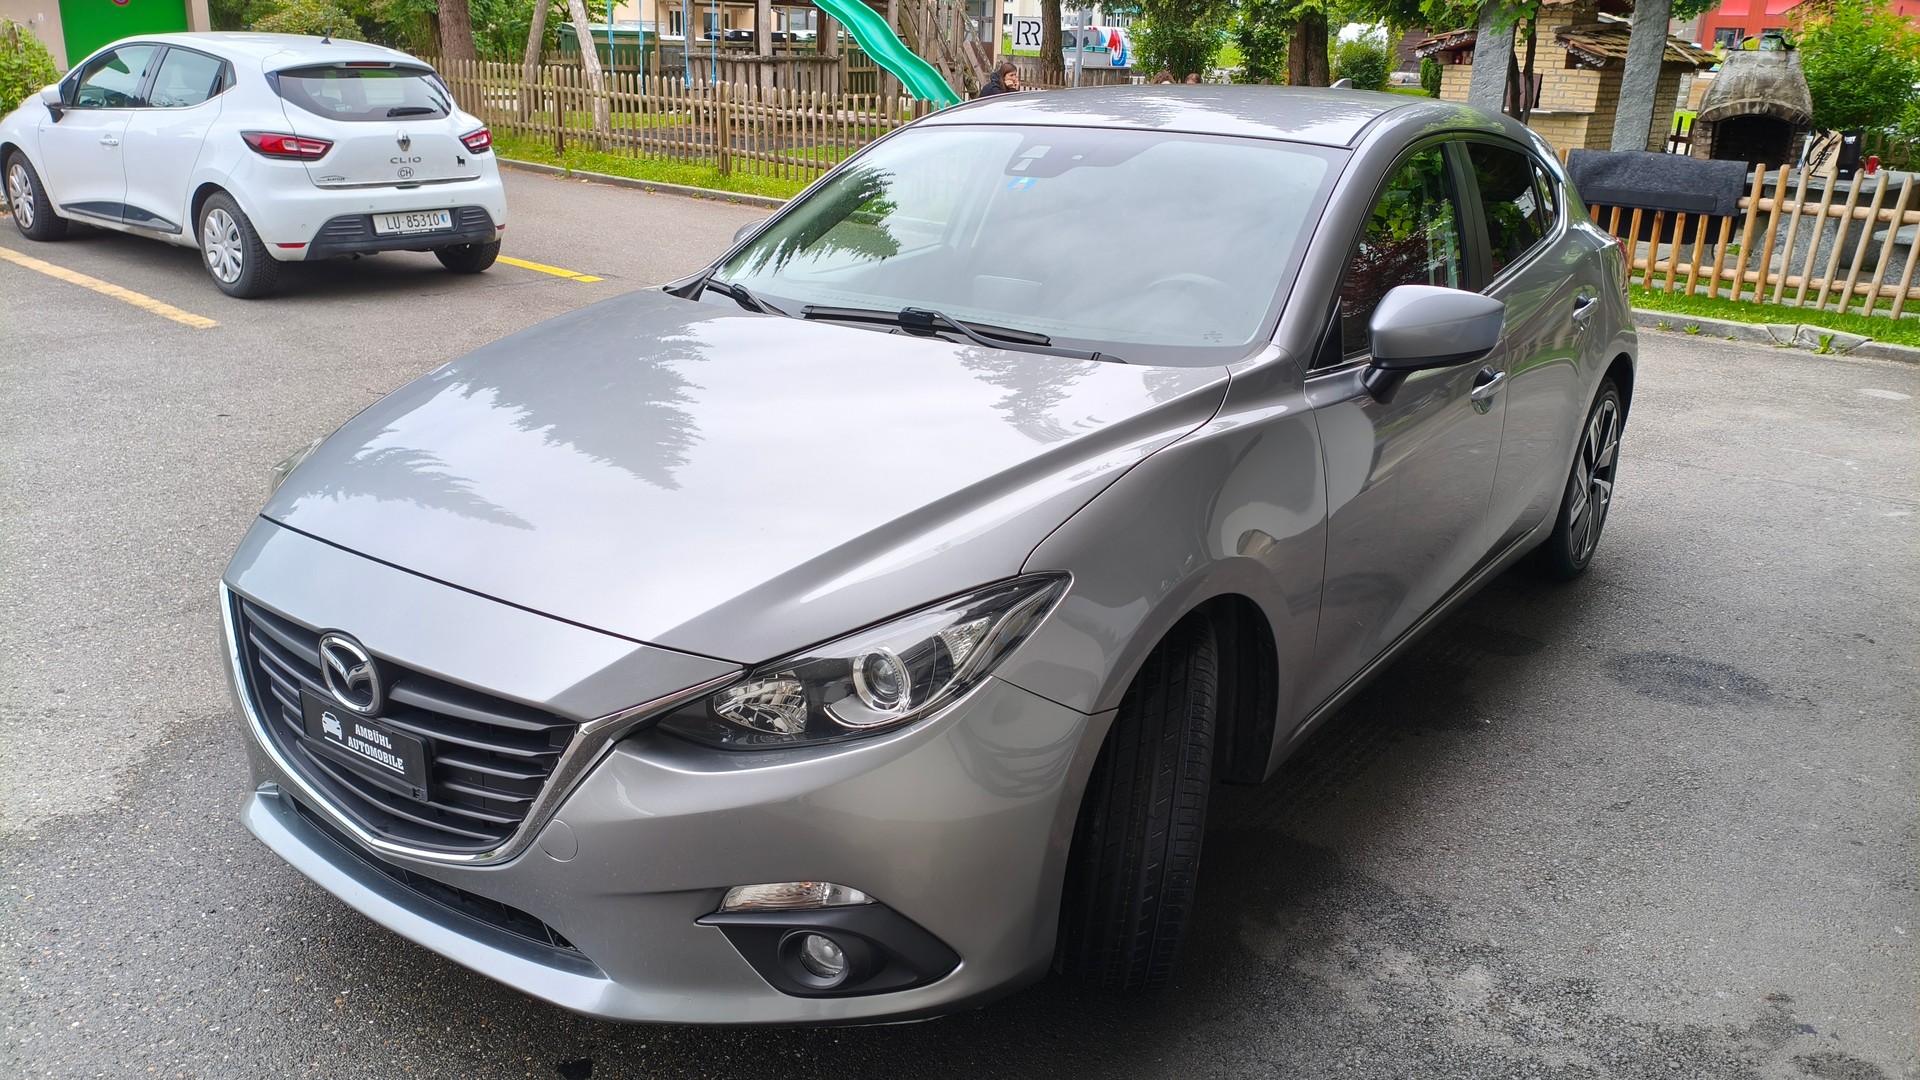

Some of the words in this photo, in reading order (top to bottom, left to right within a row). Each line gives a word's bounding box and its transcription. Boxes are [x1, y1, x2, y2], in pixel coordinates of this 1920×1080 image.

[399, 169, 411, 177] CH
[355, 723, 391, 749] AMBÜHL
[348, 736, 404, 770] AUTOMOBILE
